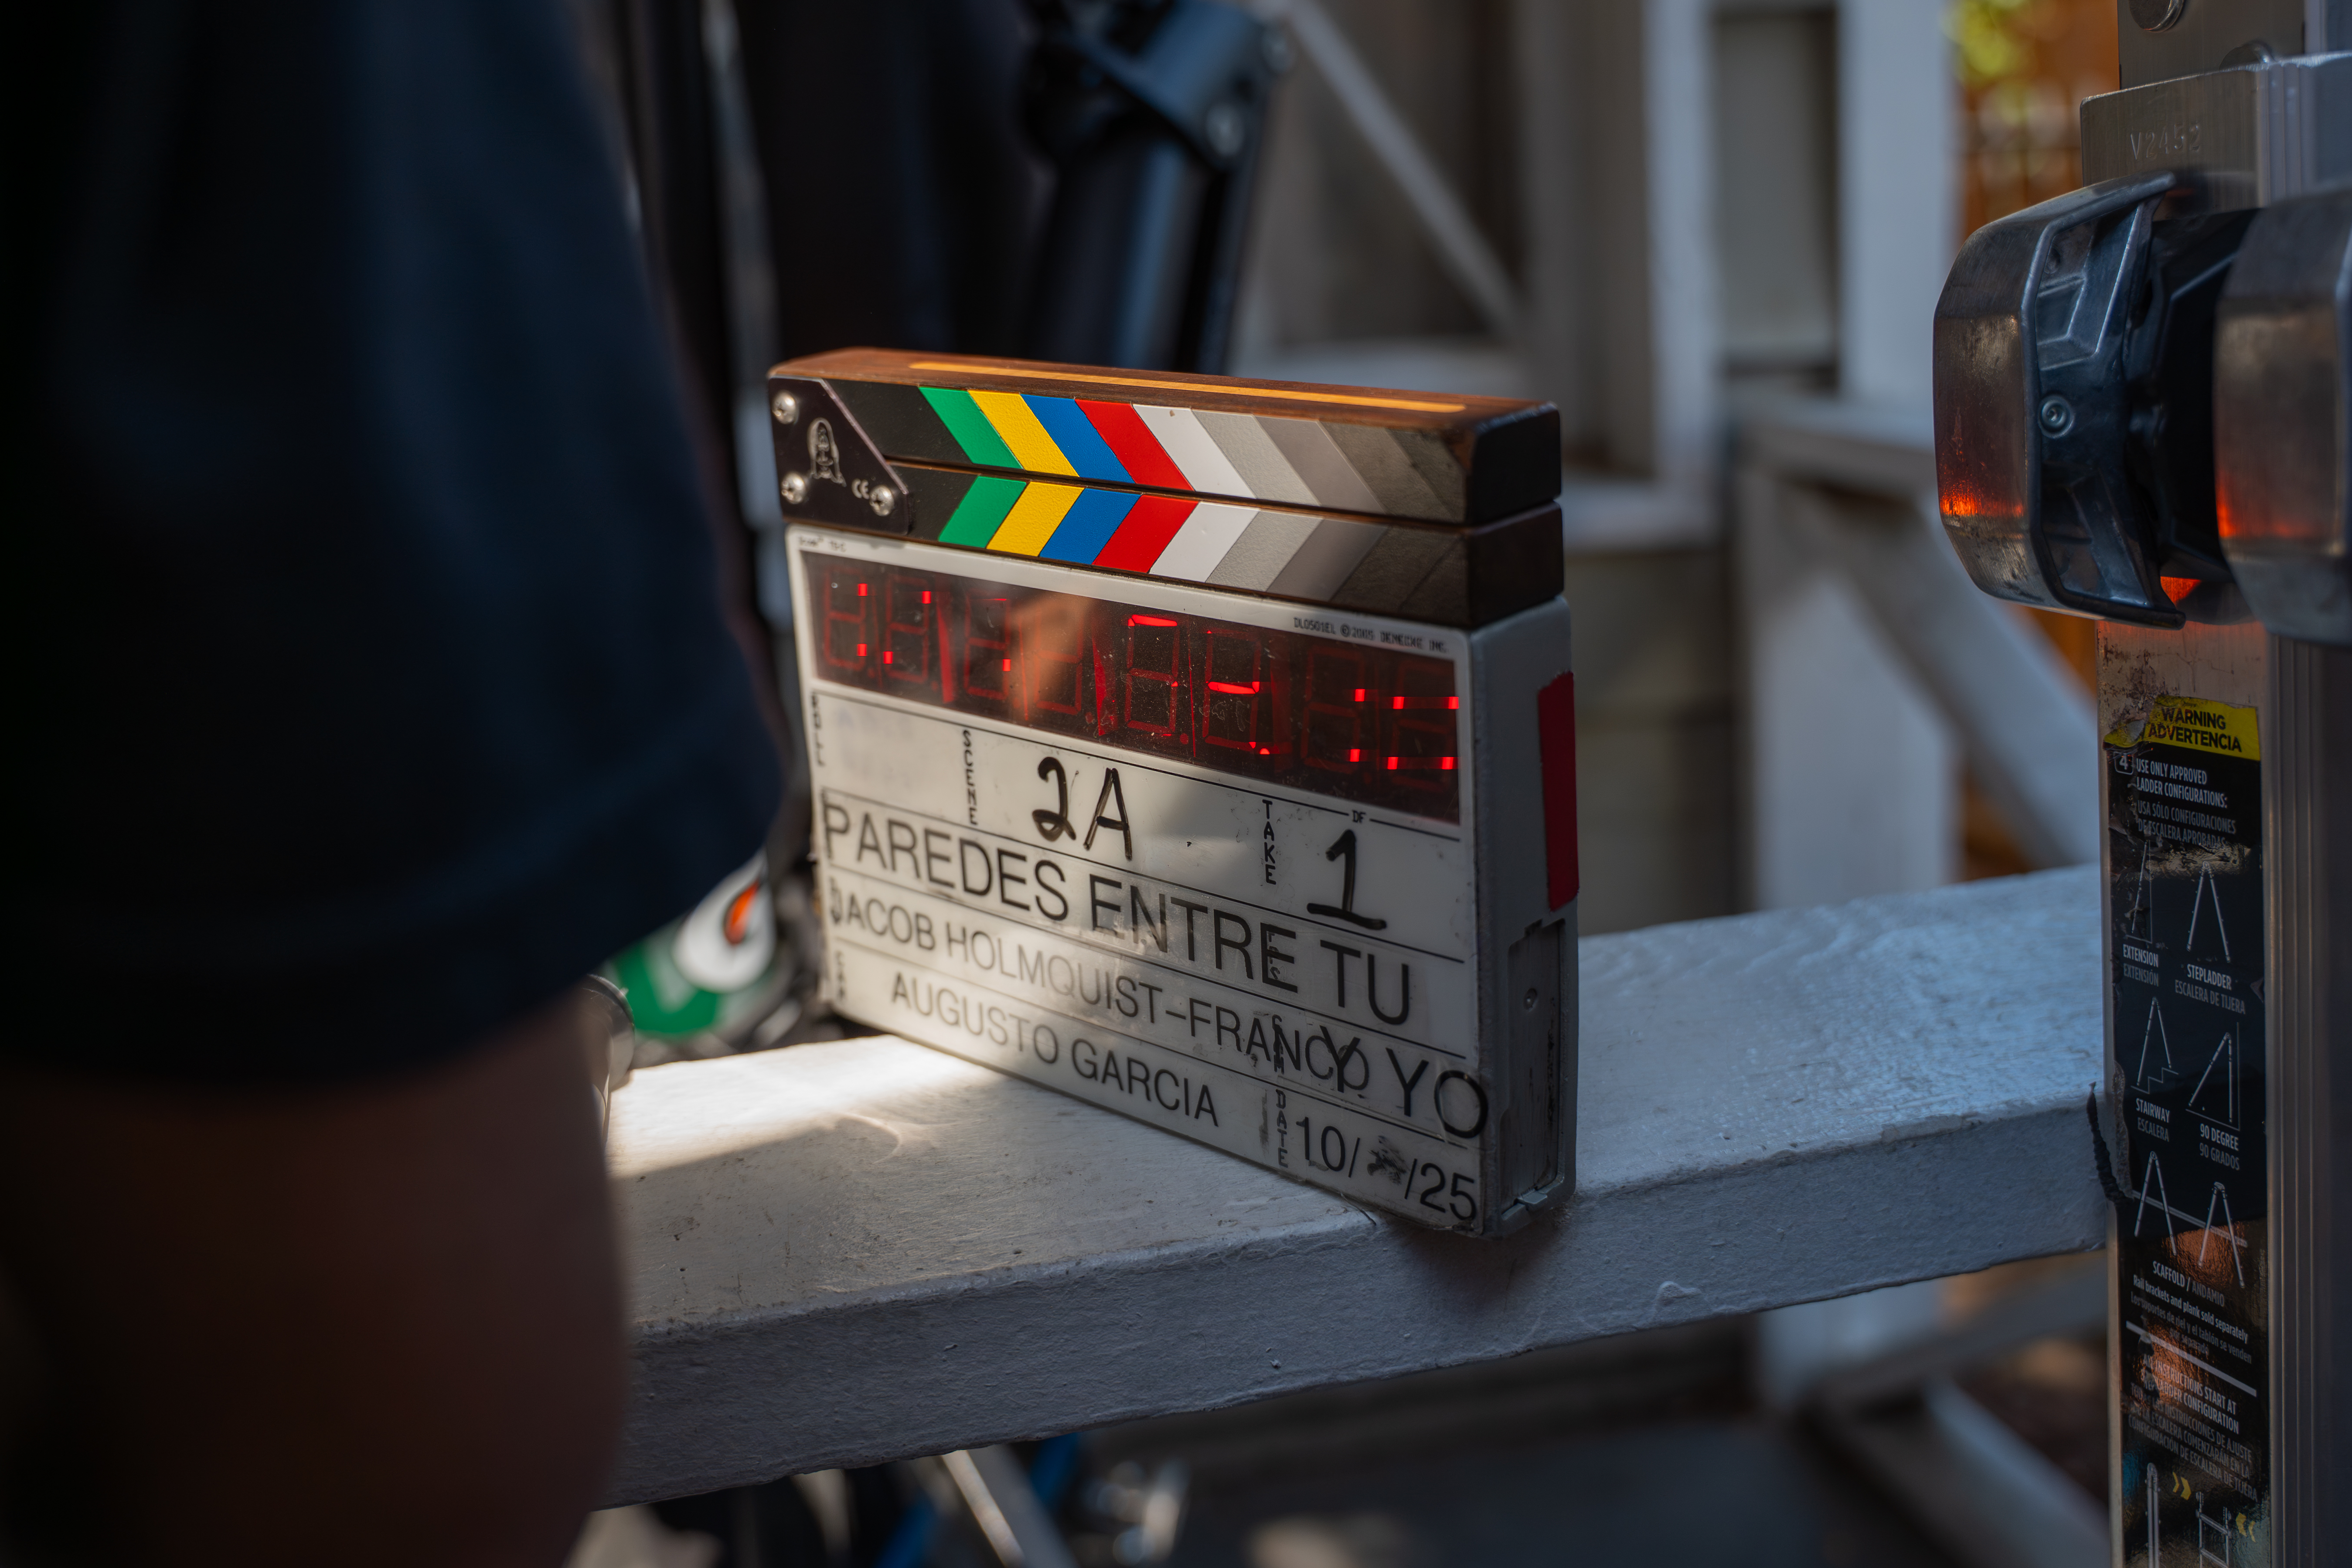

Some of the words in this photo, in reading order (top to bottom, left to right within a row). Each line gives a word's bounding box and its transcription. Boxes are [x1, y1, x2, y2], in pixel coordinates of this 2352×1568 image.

[2161, 707, 2226, 730] WARNING
[2148, 723, 2242, 752] ADVERTENCIA
[2119, 753, 2128, 770] 4
[2136, 758, 2149, 774] USE
[2150, 761, 2168, 778] ONLY
[2169, 764, 2208, 785] APPROVED
[963, 729, 978, 825] SCENE
[2137, 776, 2163, 796] LADDER
[2165, 782, 2228, 809] CONFIGURATIONS:
[1032, 756, 1133, 861] 2A
[1352, 810, 1366, 823] DF
[2138, 799, 2151, 816] USA
[2152, 801, 2169, 820] SÓLO
[2171, 807, 2236, 835] CONFIGURACIONES
[1262, 799, 1276, 885] TAKE
[1307, 829, 1387, 930] 1
[822, 803, 1068, 921] PAREDES
[1089, 874, 1298, 993] ENTRE
[1320, 939, 1409, 1026] TU
[830, 889, 936, 951] JACOB
[2123, 944, 2159, 967] EXTENSION
[2124, 963, 2159, 987] EXTENSIÓN
[2187, 963, 2232, 990] STEPLADDER
[2175, 979, 2209, 1003] ESCALERA
[2210, 990, 2219, 1007] DE
[892, 972, 1059, 1065] AUGUSTO
[1072, 1039, 1219, 1127] GARCIA
[1319, 1025, 1361, 1093] Y
[1385, 1048, 1488, 1138] YO
[2136, 1098, 2170, 1123] STAIRWAY
[1276, 1089, 1288, 1168] DATE
[2138, 1117, 2169, 1142] ESCALERA
[2200, 1122, 2209, 1139] 90
[2211, 1127, 2239, 1151] DEGREE
[2199, 1142, 2209, 1158] 90
[2210, 1146, 2240, 1171] GRADOS
[2152, 1260, 2185, 1287] SCAFFOLD
[2192, 1280, 2225, 1307] ANDAMIO
[2133, 1274, 2144, 1290] Rail
[2145, 1280, 2170, 1303] brackets
[2170, 1295, 2182, 1309] and
[2183, 1301, 2200, 1319] plank
[2201, 1311, 2215, 1326] sold
[2215, 1318, 2249, 1344] separately
[2167, 1310, 2174, 1324] de
[2186, 1322, 2191, 1334] y
[2192, 1324, 2198, 1336] el
[2219, 1340, 2227, 1351] se
[2228, 1343, 2252, 1364] venden
[2183, 1392, 2240, 1435] CONFIGURATION
[2204, 1386, 2226, 1410] START
[2227, 1398, 2237, 1415] AT
[2180, 1444, 2189, 1461] DE
[2216, 1431, 2226, 1448] DE
